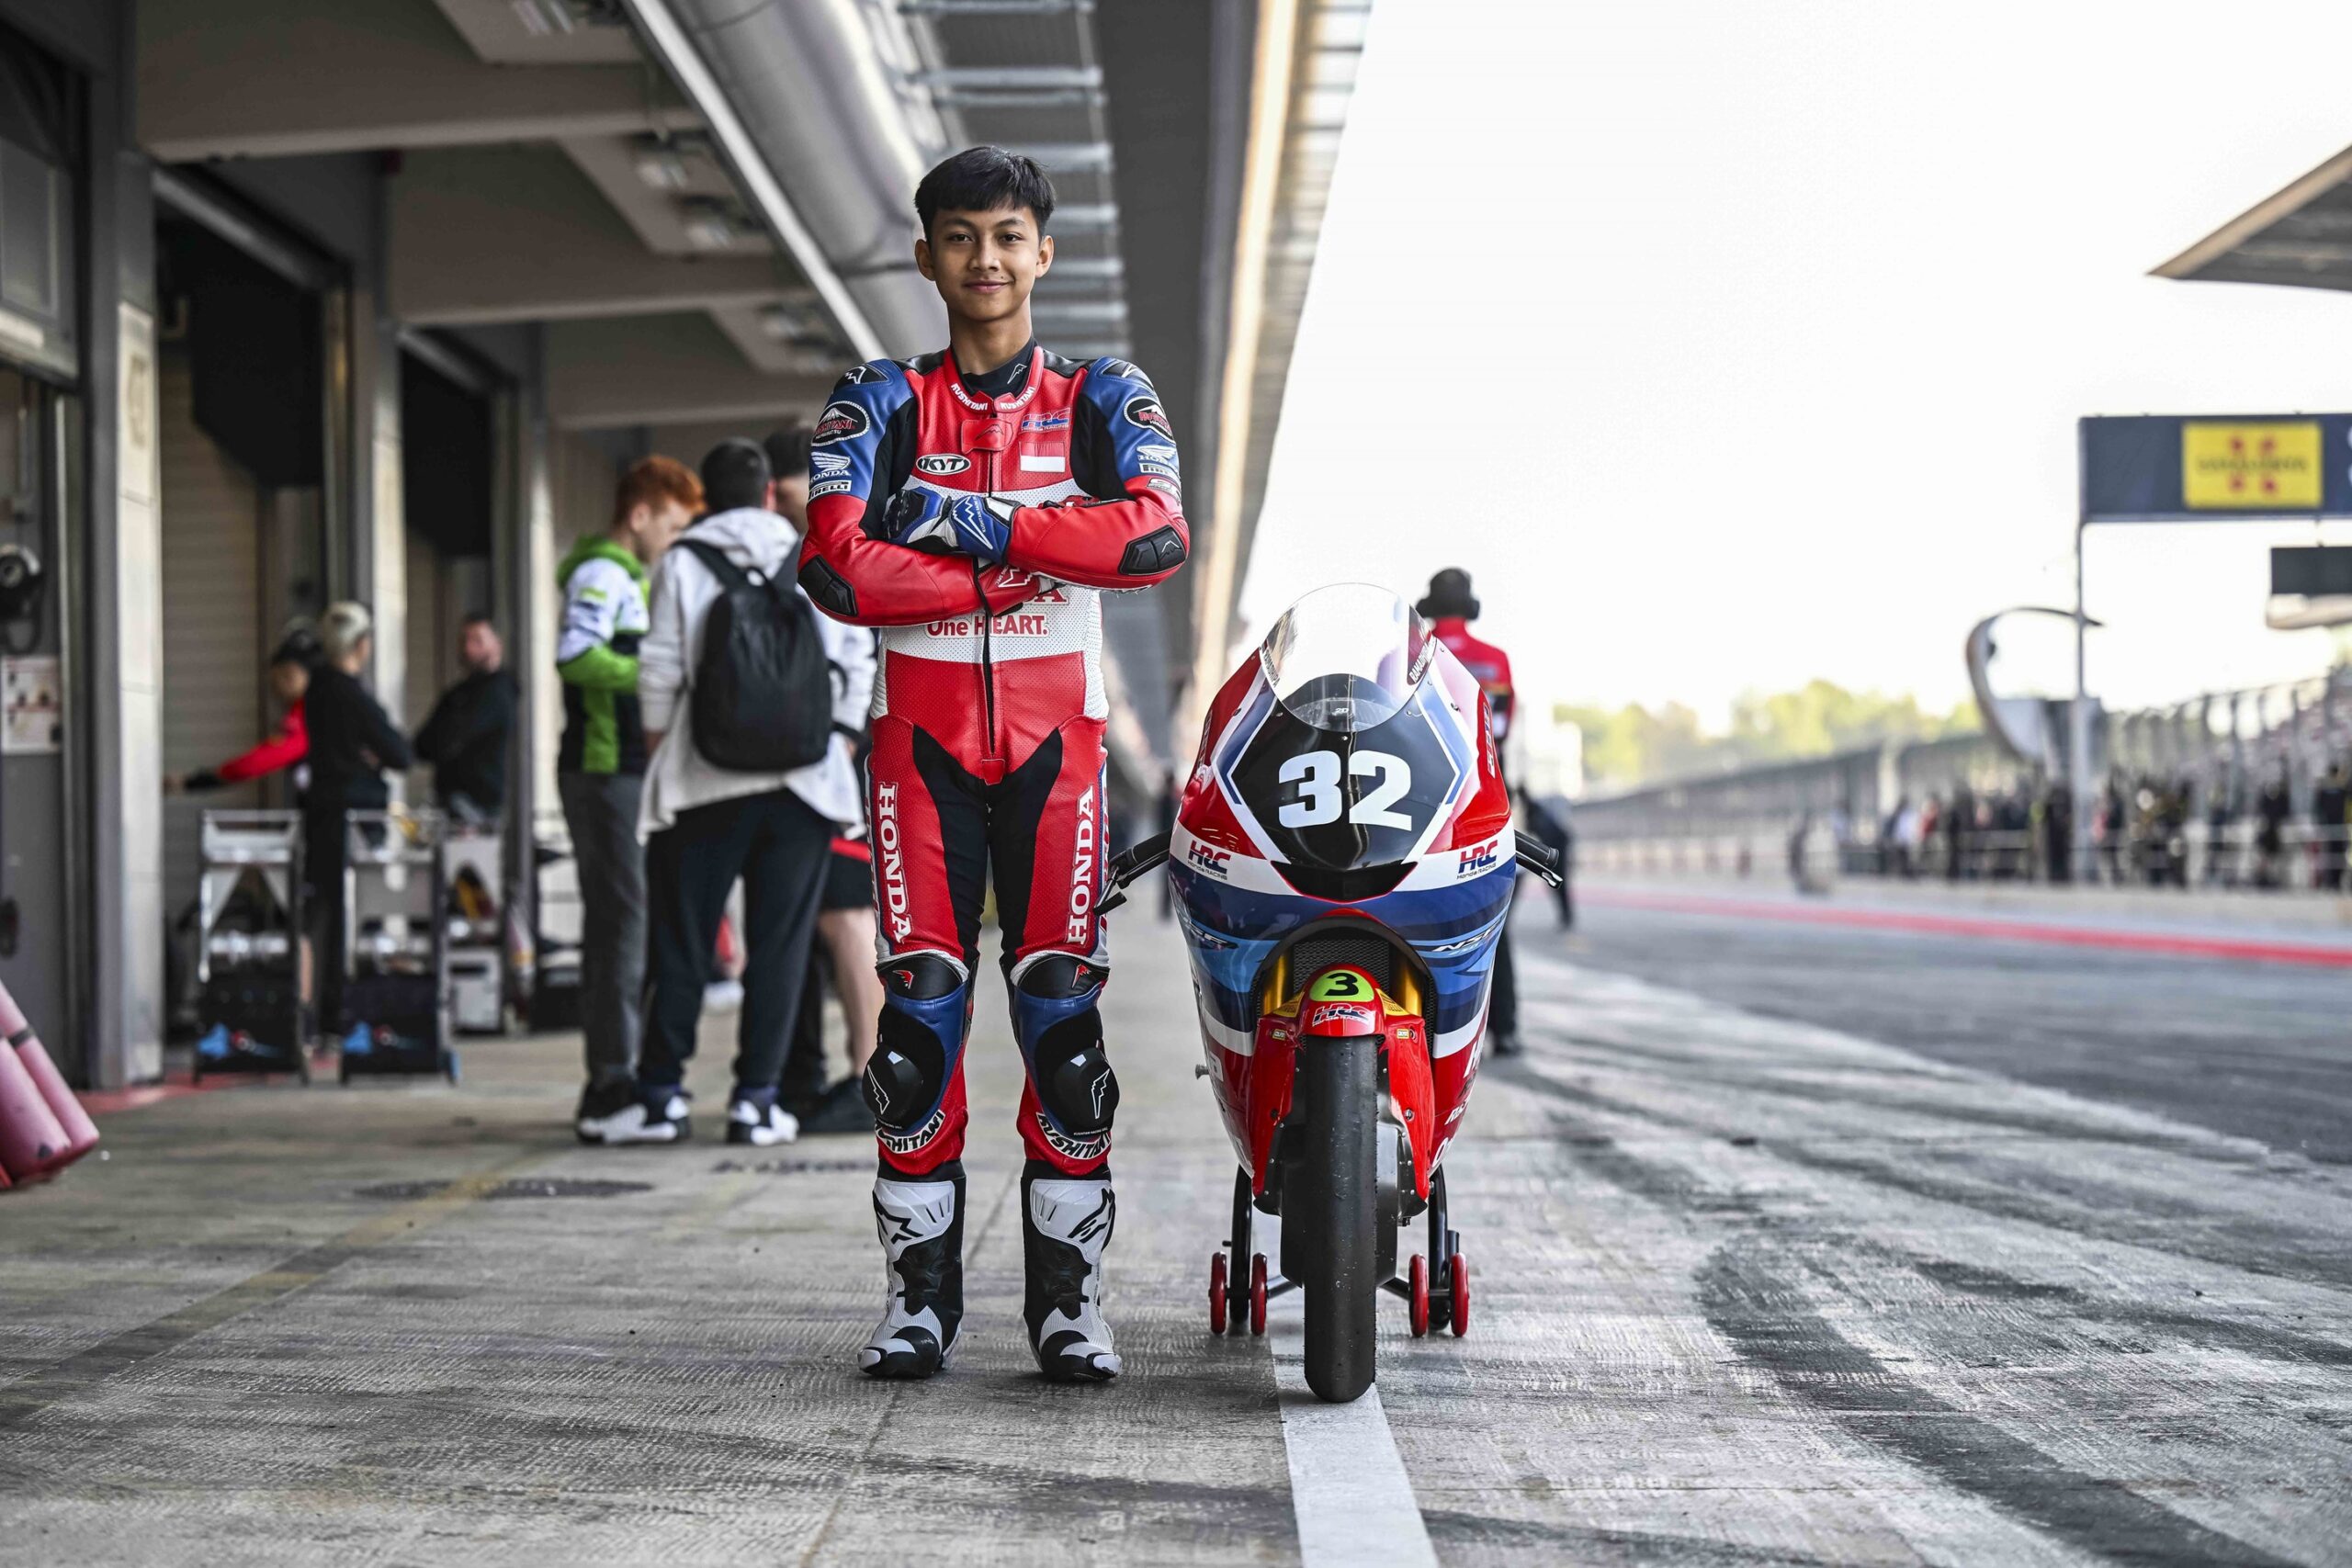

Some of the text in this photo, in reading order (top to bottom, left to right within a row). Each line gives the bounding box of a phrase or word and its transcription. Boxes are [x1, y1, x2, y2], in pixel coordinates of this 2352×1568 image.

[922, 457, 965, 471] KYT
[809, 480, 850, 500] IRELLI
[927, 615, 1048, 637] One HEART.
[1277, 749, 1413, 831] 32
[878, 783, 912, 944] HONDA
[1067, 784, 1094, 946] HONDA
[1188, 840, 1231, 874] HRC
[1458, 840, 1498, 874] HRC
[1323, 972, 1360, 997] 3
[877, 1110, 945, 1152] SHITANI
